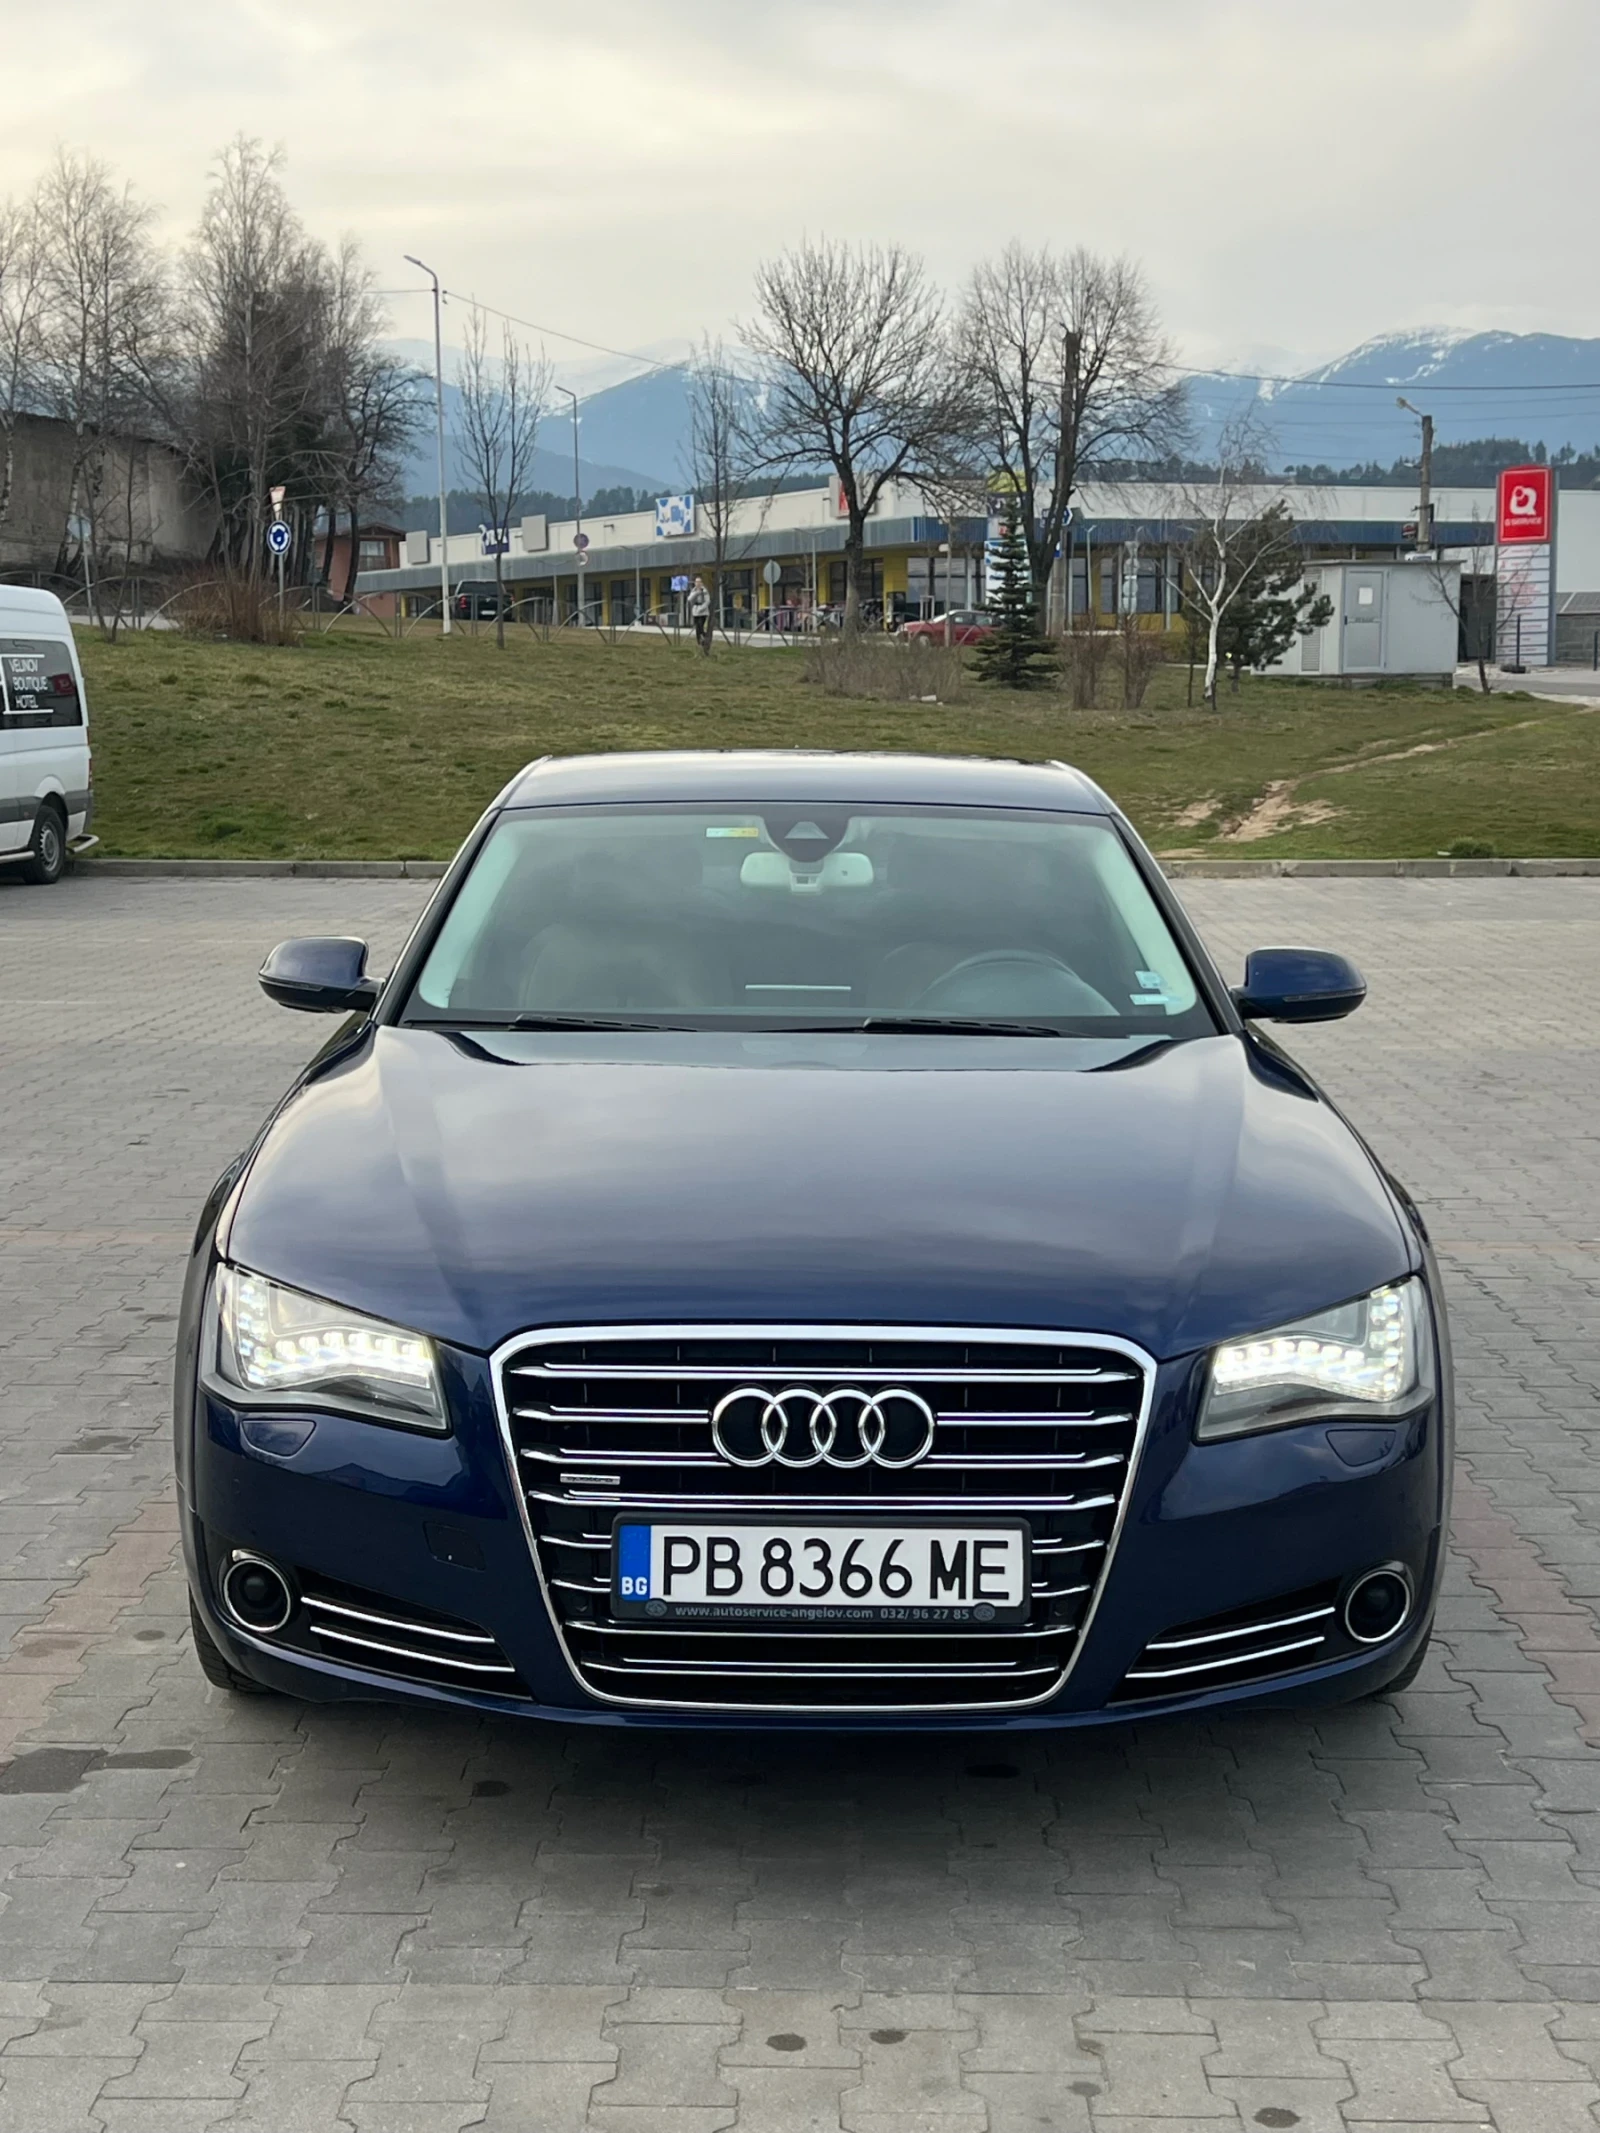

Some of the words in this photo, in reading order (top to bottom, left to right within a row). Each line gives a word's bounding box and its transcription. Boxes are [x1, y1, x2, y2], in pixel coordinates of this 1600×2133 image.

[12, 676, 48, 692] BOUTIQUE
[15, 694, 39, 708] HOTEL
[662, 1536, 743, 1596] PB
[760, 1538, 913, 1598] 8366
[929, 1540, 1010, 1600] ME
[621, 1577, 647, 1595] BG
[675, 1606, 873, 1620] www.autoservice-angelov.com
[880, 1607, 909, 1620] 032/
[912, 1607, 929, 1620] 96
[932, 1608, 949, 1620] 27
[953, 1608, 970, 1620] 85
